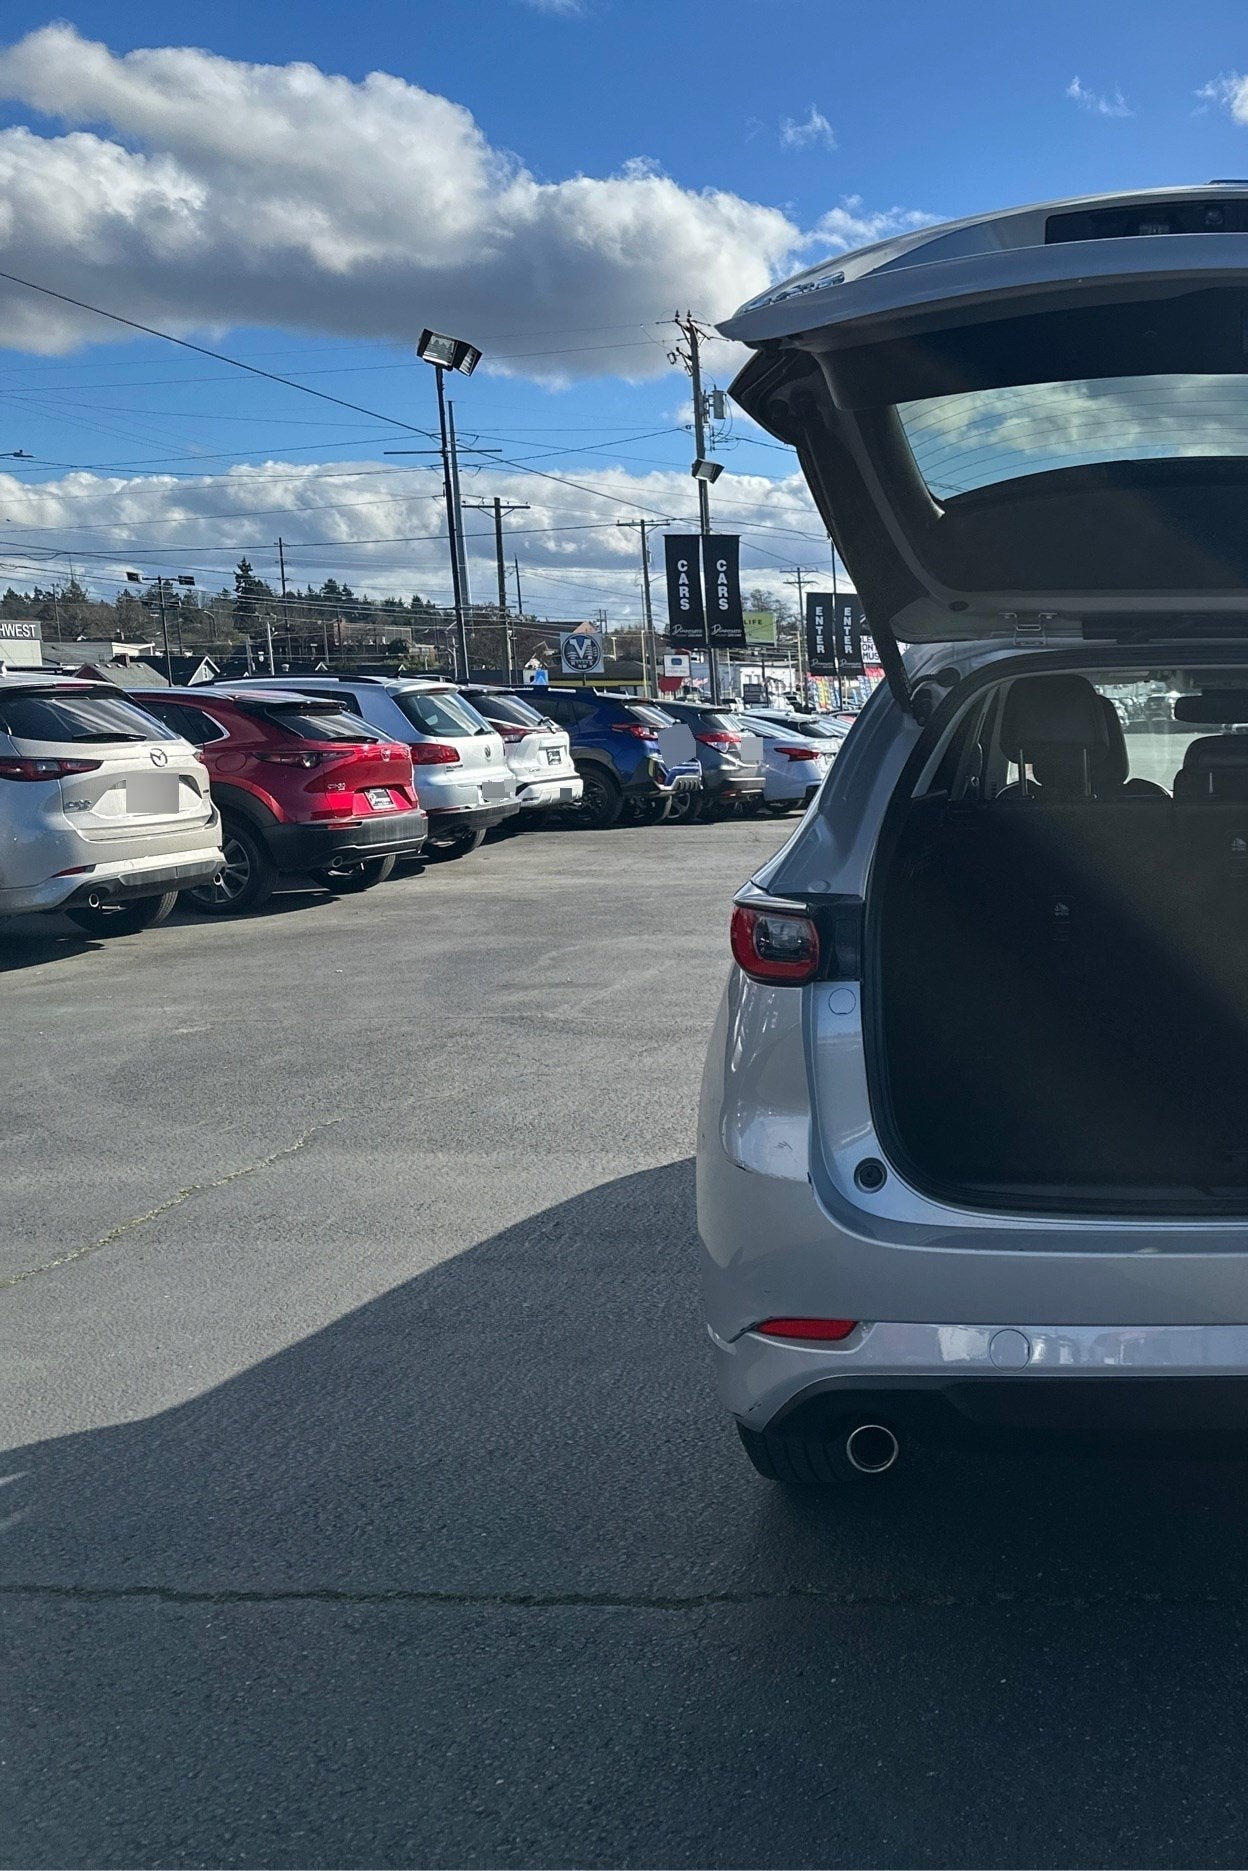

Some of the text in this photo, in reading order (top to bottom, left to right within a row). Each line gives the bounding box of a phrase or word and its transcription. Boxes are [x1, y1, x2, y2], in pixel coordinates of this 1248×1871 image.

[677, 559, 690, 610] CARS
[716, 559, 729, 610] CARS
[815, 606, 825, 654] ENTER
[843, 607, 853, 654] ENTER
